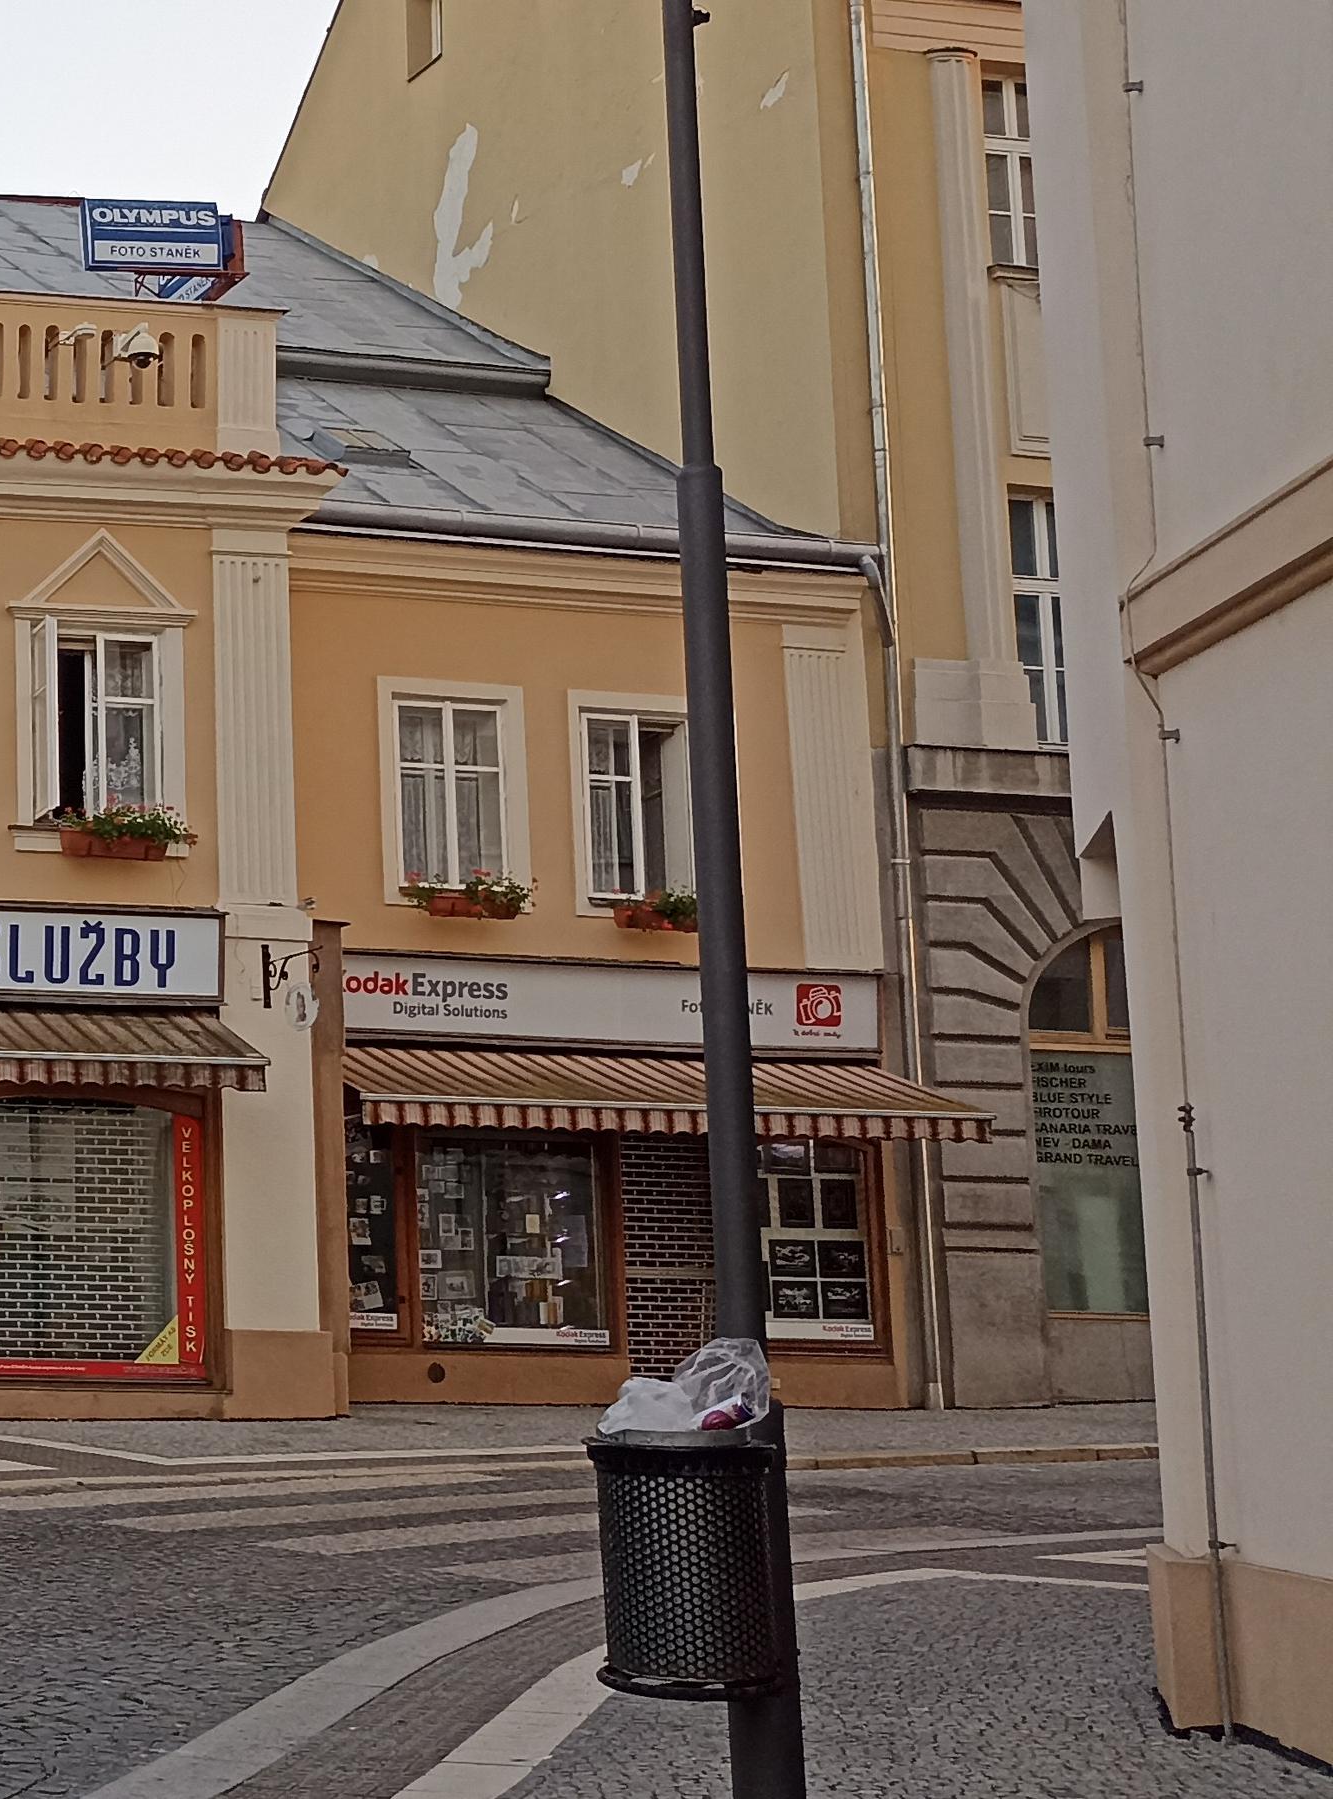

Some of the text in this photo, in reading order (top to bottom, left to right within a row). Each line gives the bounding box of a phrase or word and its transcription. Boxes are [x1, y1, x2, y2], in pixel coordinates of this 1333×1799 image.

[92, 208, 216, 226] OLYMPUS
[110, 245, 201, 259] FOTO STANĚK
[342, 970, 509, 1003] odak Express
[393, 1001, 508, 1020] Digital Solutions
[681, 999, 704, 1013] Fot
[1064, 1063, 1096, 1074] tours
[1032, 1092, 1112, 1105] BLUE STYLE
[1095, 1124, 1137, 1136] TRAVE
[1072, 1138, 1112, 1149] DAMA
[1037, 1151, 1139, 1167] GRAND TRAVEL
[185, 1296, 197, 1353] TISK
